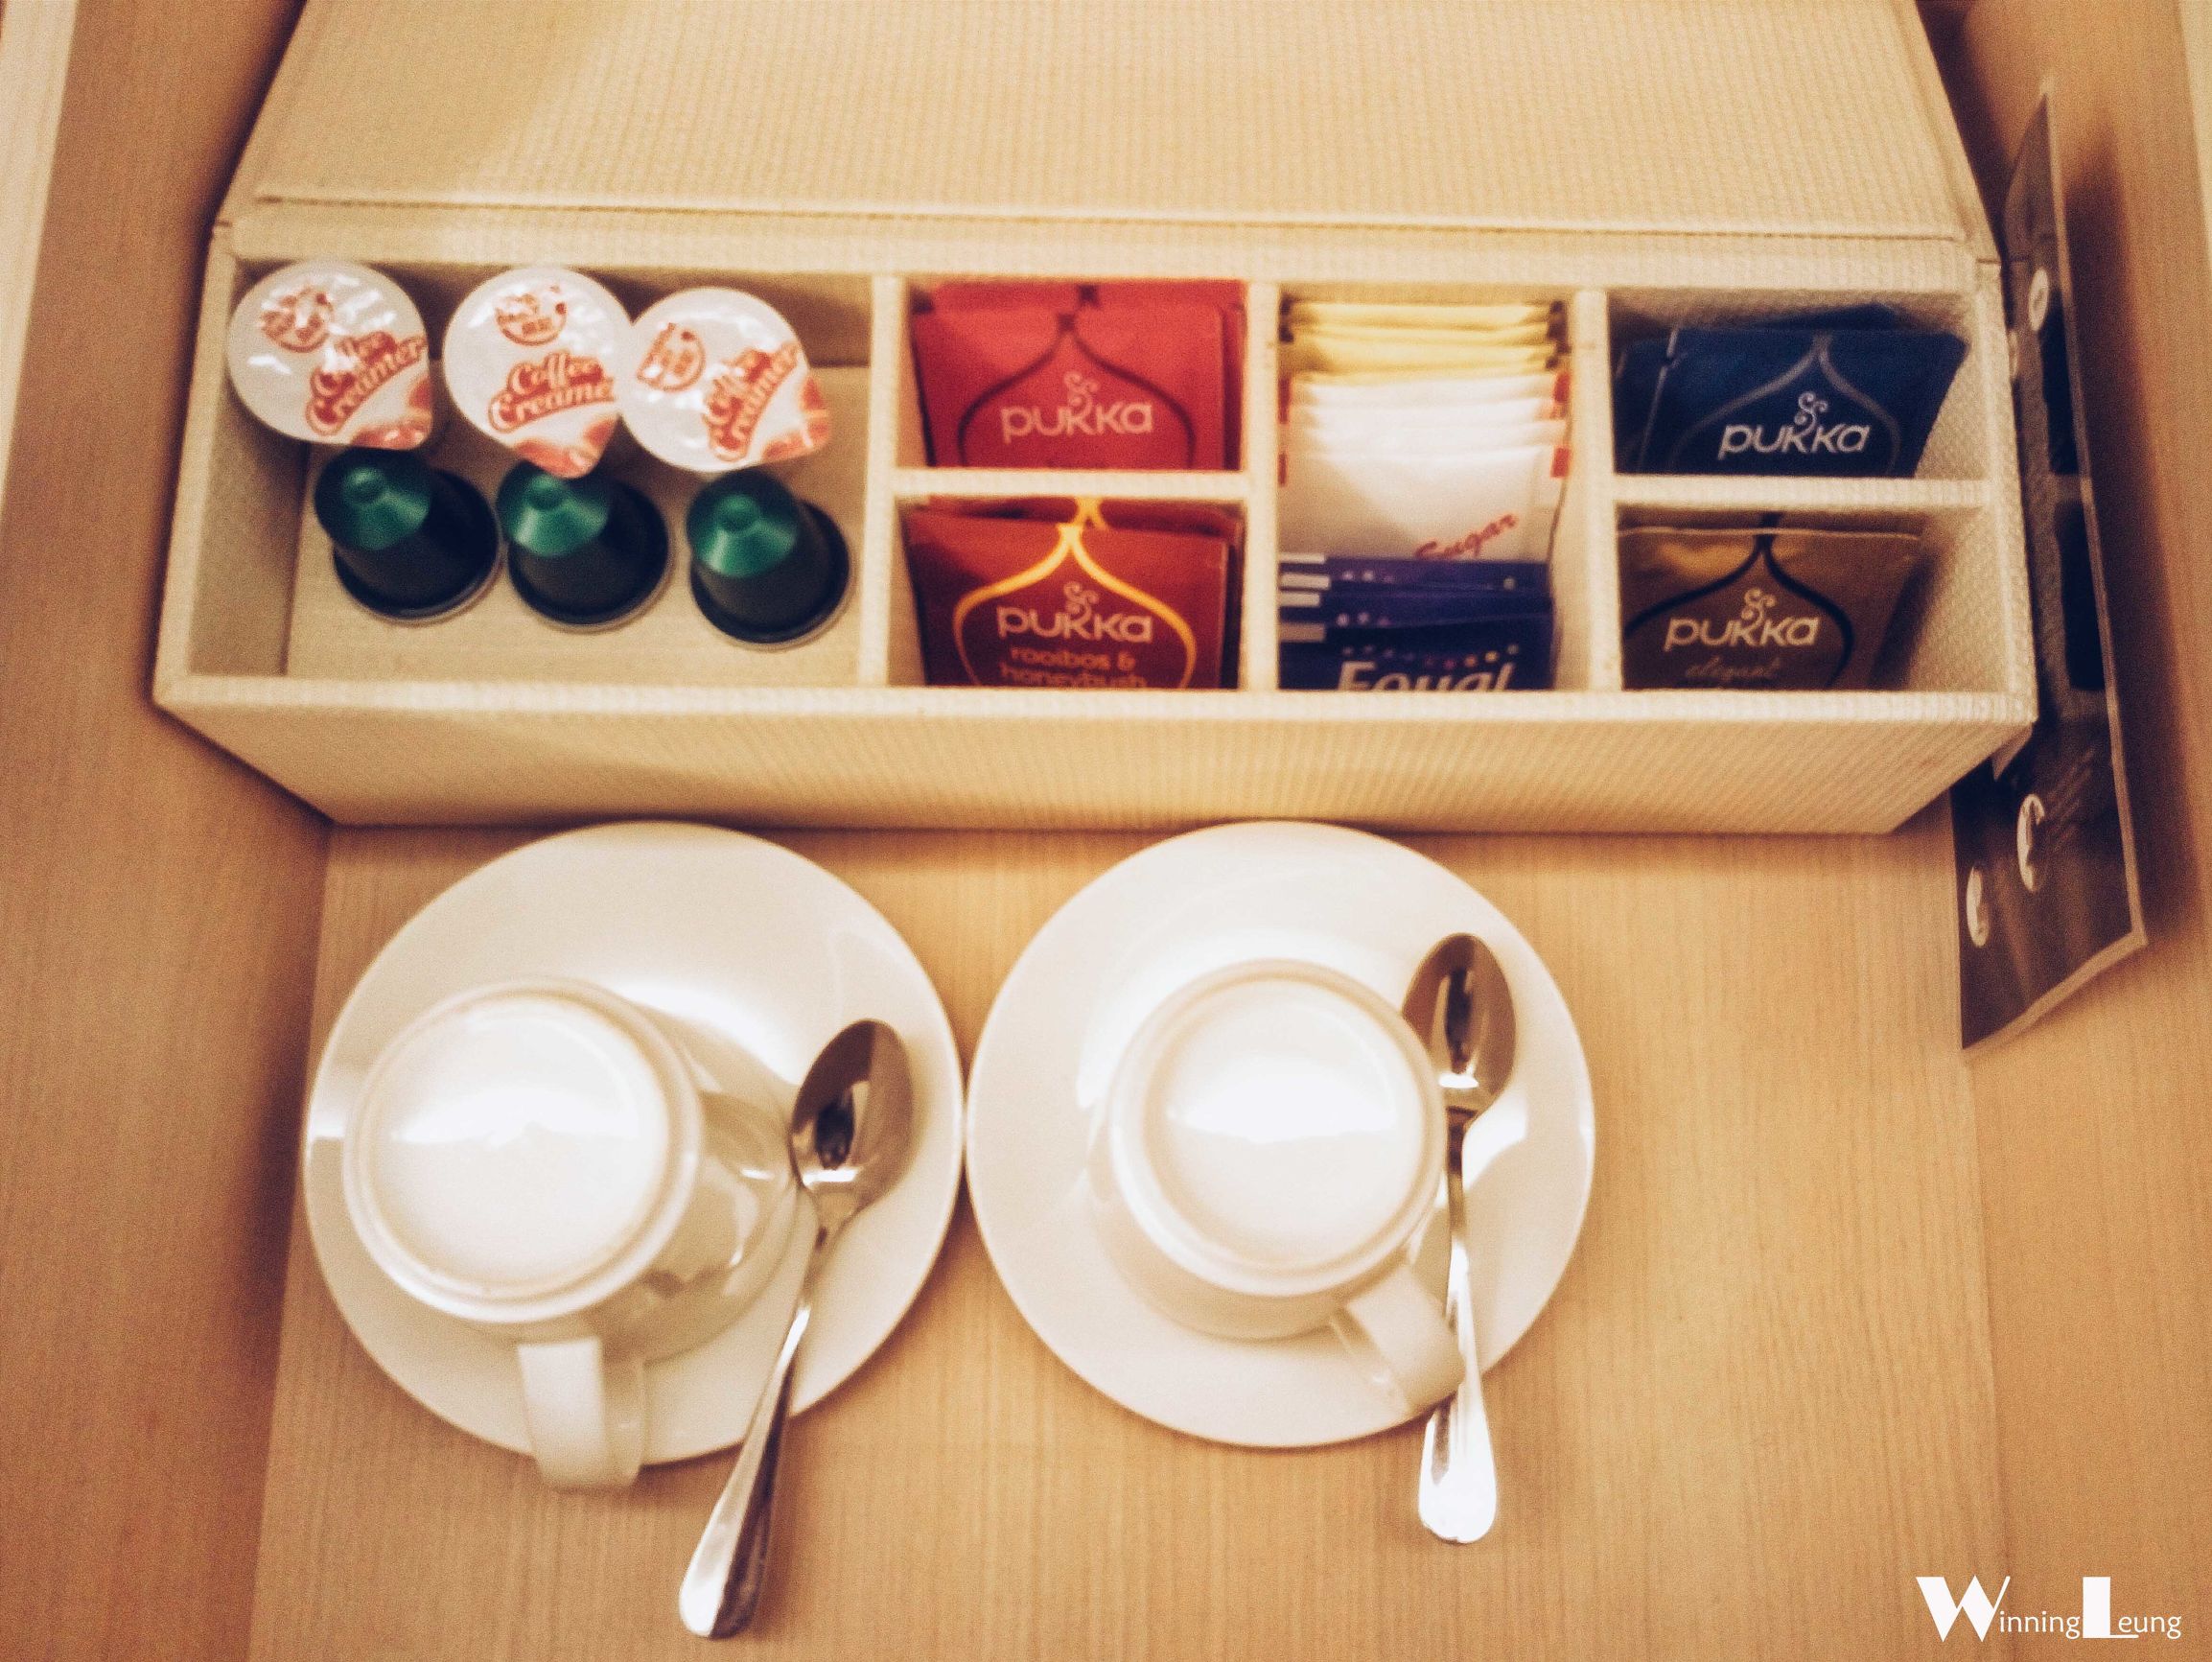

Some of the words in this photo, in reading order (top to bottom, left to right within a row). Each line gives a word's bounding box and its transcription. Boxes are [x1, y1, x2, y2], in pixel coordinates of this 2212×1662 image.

[507, 349, 604, 399] Coffee
[488, 377, 615, 433] Creame
[1011, 645, 1111, 670] rooibos
